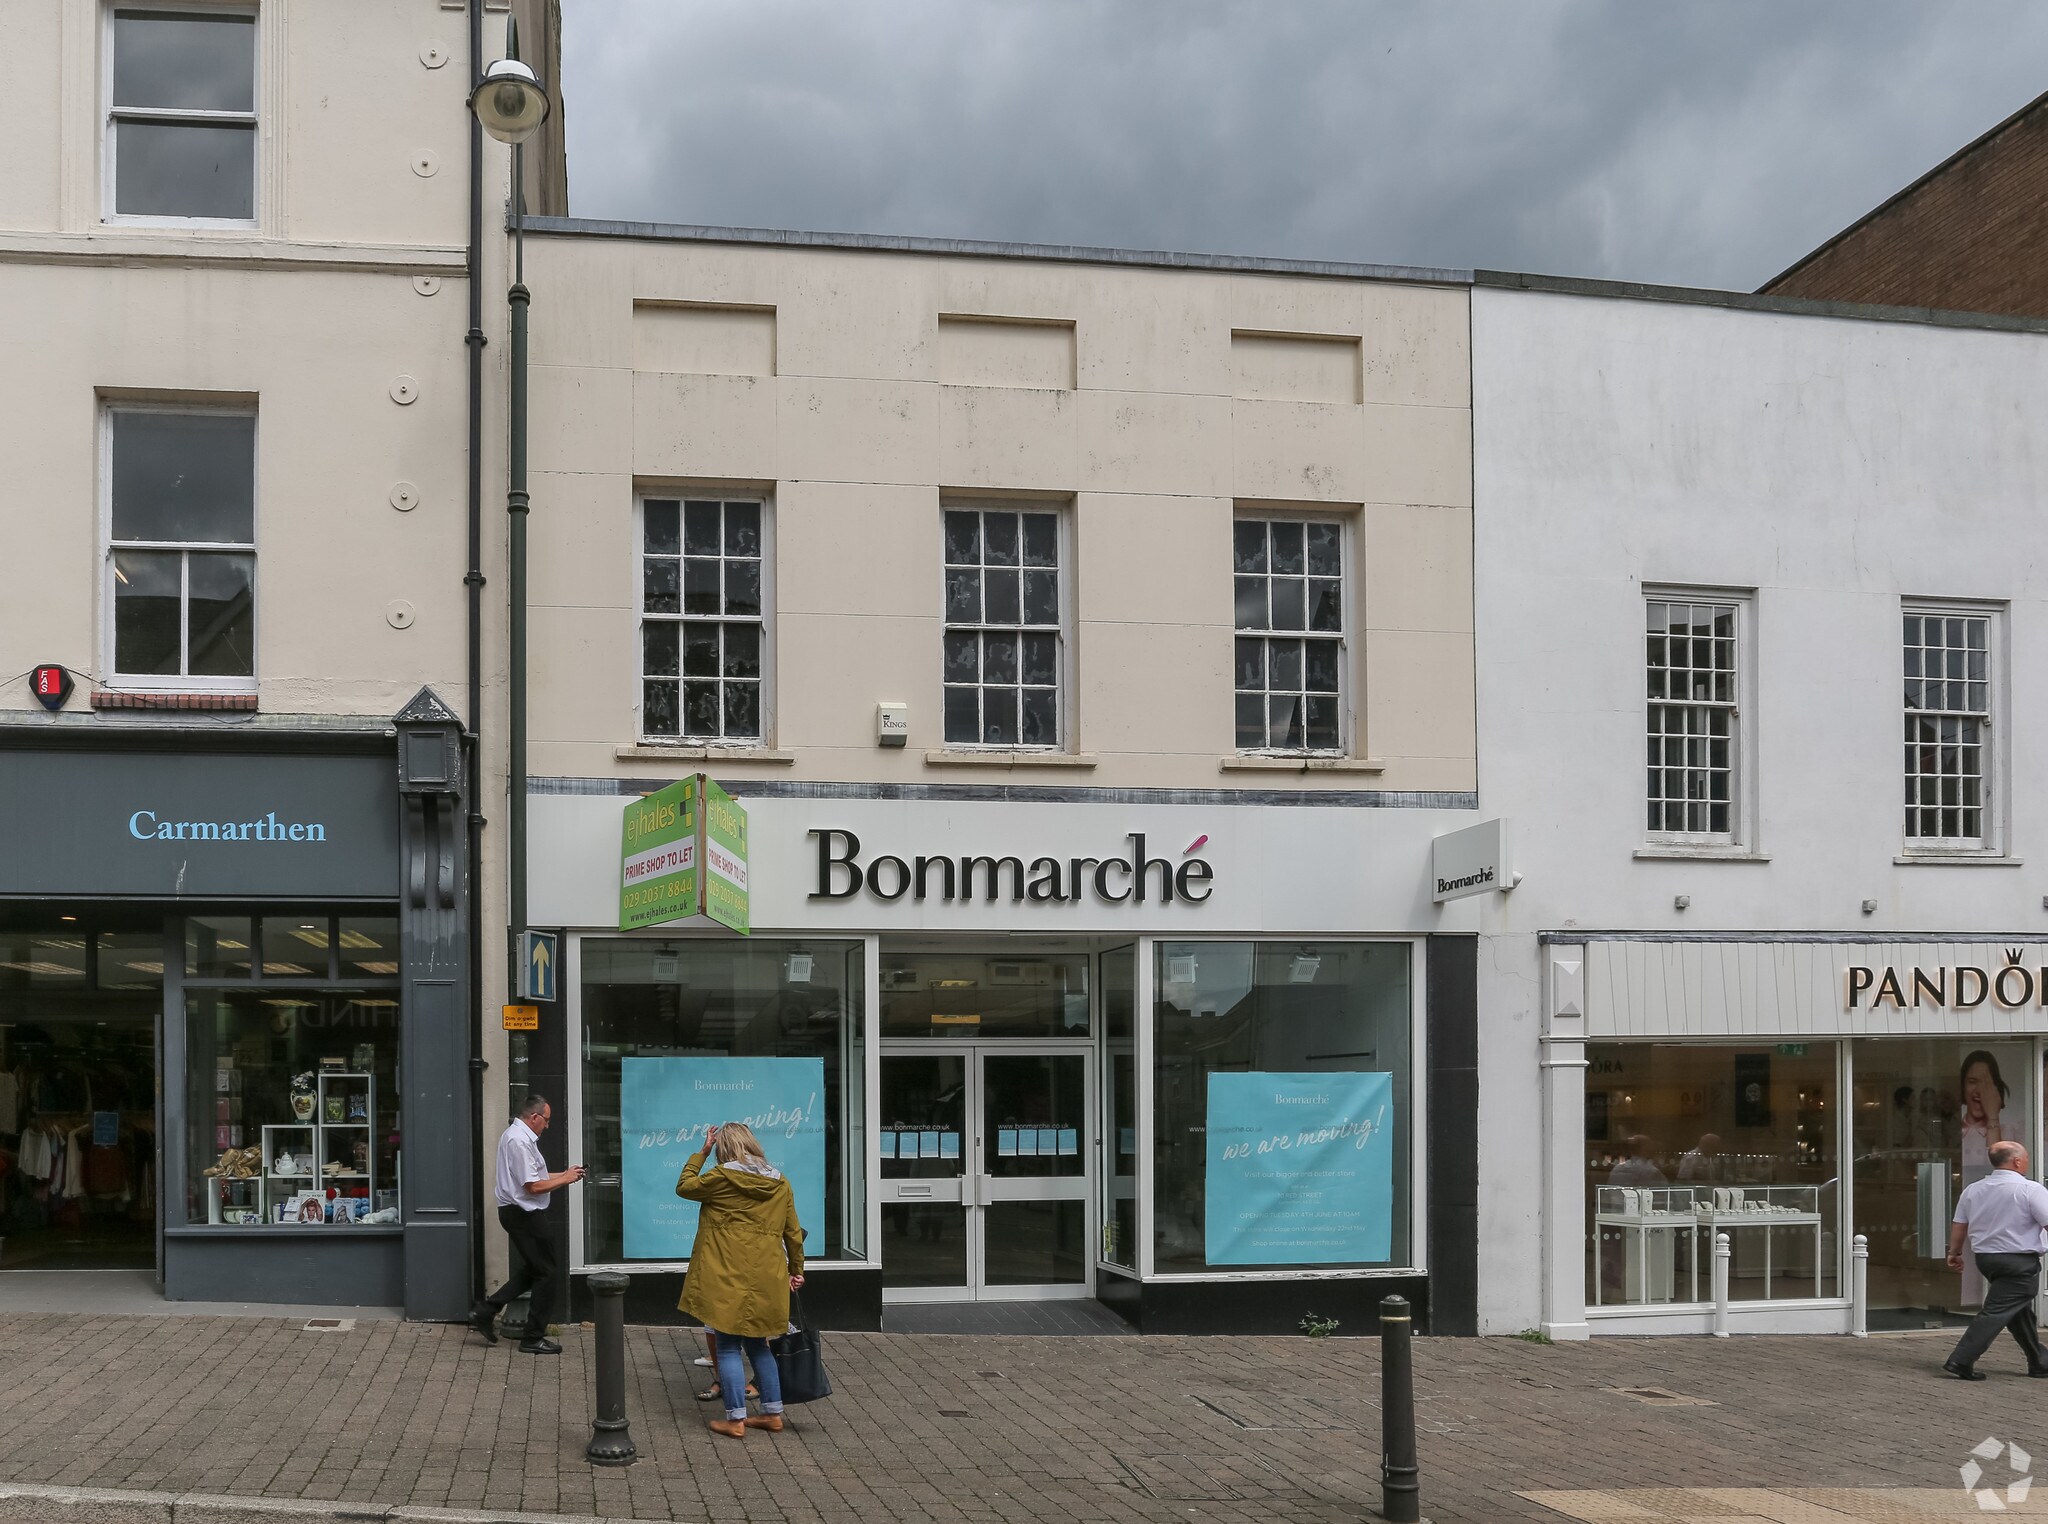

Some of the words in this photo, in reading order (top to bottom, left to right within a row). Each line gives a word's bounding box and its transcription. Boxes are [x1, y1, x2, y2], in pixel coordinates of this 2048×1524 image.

[40, 670, 49, 693] FAS
[128, 809, 327, 842] Carmarthen
[625, 861, 645, 880] PRIME
[646, 855, 666, 873] SHOP
[667, 851, 678, 867] TO
[679, 846, 693, 864] LET
[709, 847, 721, 869] PRIME
[722, 856, 733, 875] SHOP
[806, 828, 1215, 904] Bonmarché
[624, 892, 640, 909] 029
[642, 884, 665, 904] 2037
[667, 877, 693, 898] 8844
[709, 879, 719, 897] 029
[1437, 865, 1494, 893] Bonmarché
[630, 899, 688, 922] www.ejhales.co.uk
[1849, 965, 2048, 1007] PANDO
[694, 1080, 754, 1091] Bonmarché
[1275, 1093, 1330, 1105] Bonmarché
[640, 1131, 671, 1150] we
[676, 1121, 711, 1144] are
[1222, 1142, 1252, 1160] we
[1257, 1136, 1293, 1155] are
[1296, 1105, 1385, 1150] moving!
[663, 1161, 680, 1170] Visit
